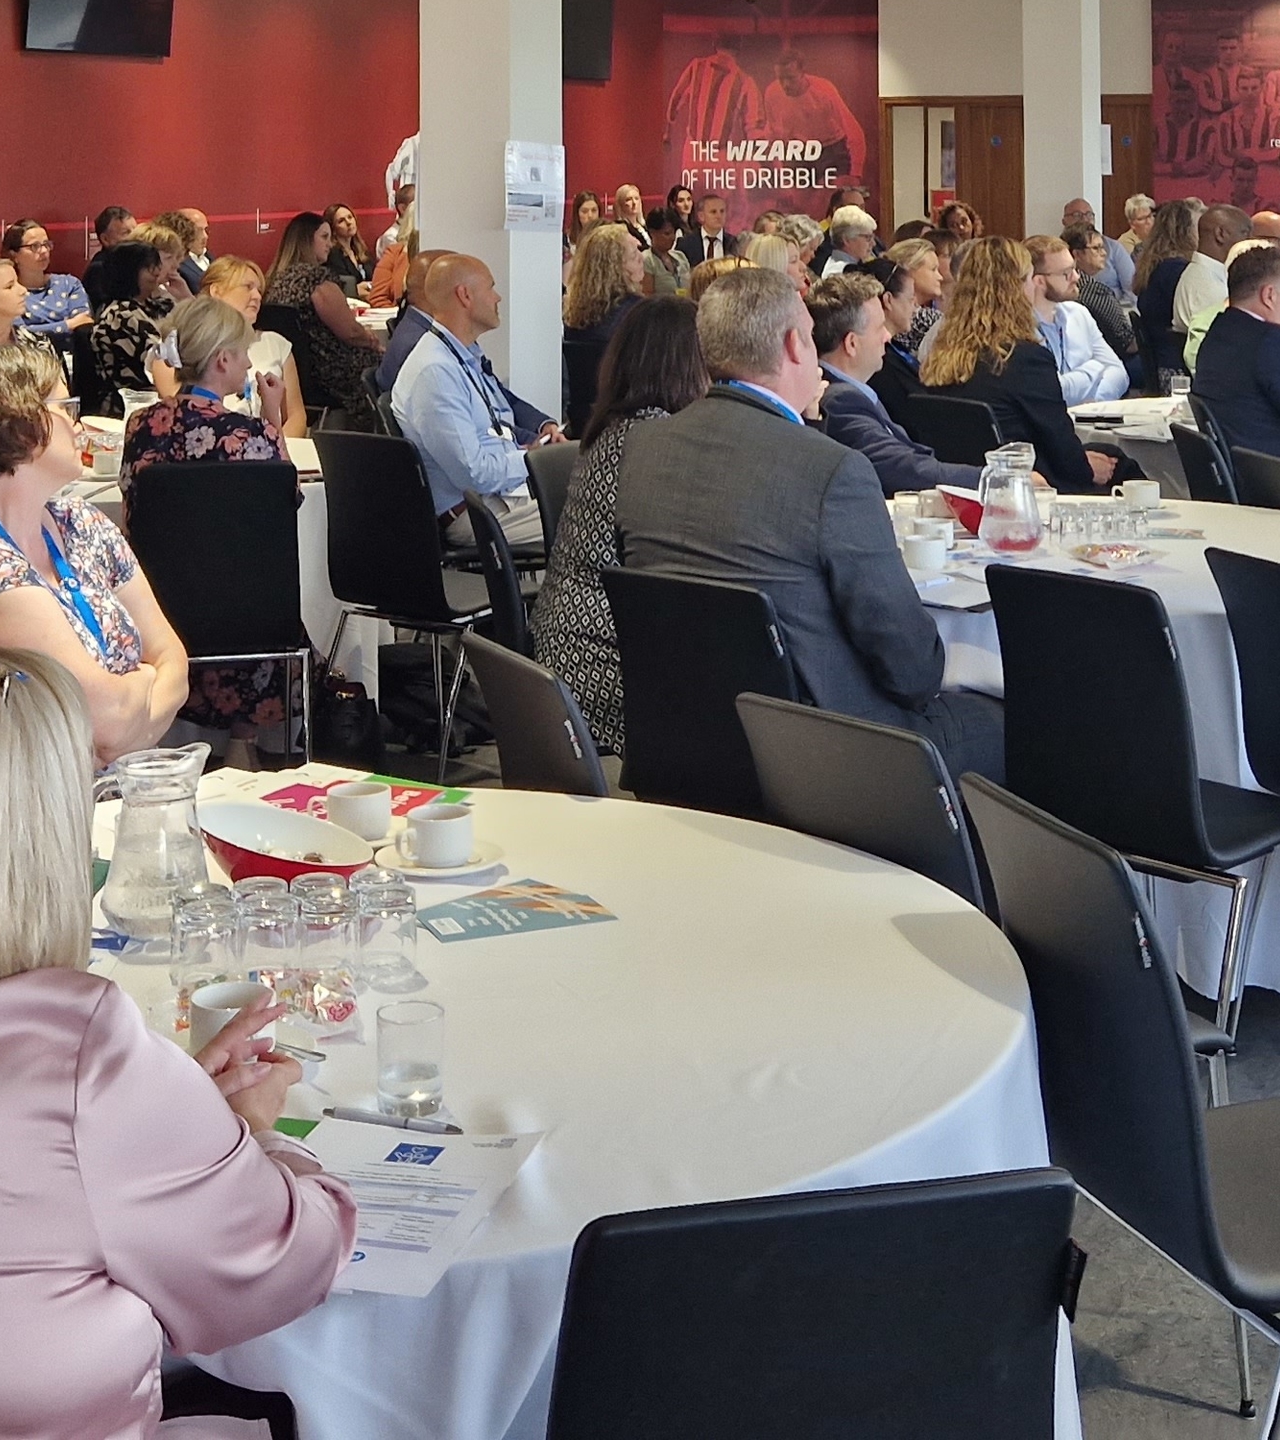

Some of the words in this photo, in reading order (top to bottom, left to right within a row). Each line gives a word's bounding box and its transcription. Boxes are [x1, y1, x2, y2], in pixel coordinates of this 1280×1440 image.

[690, 140, 719, 162] THE
[726, 140, 822, 162] WIZARD
[681, 169, 699, 190] OF
[703, 168, 736, 189] THE
[743, 167, 838, 189] DRIBBLE
